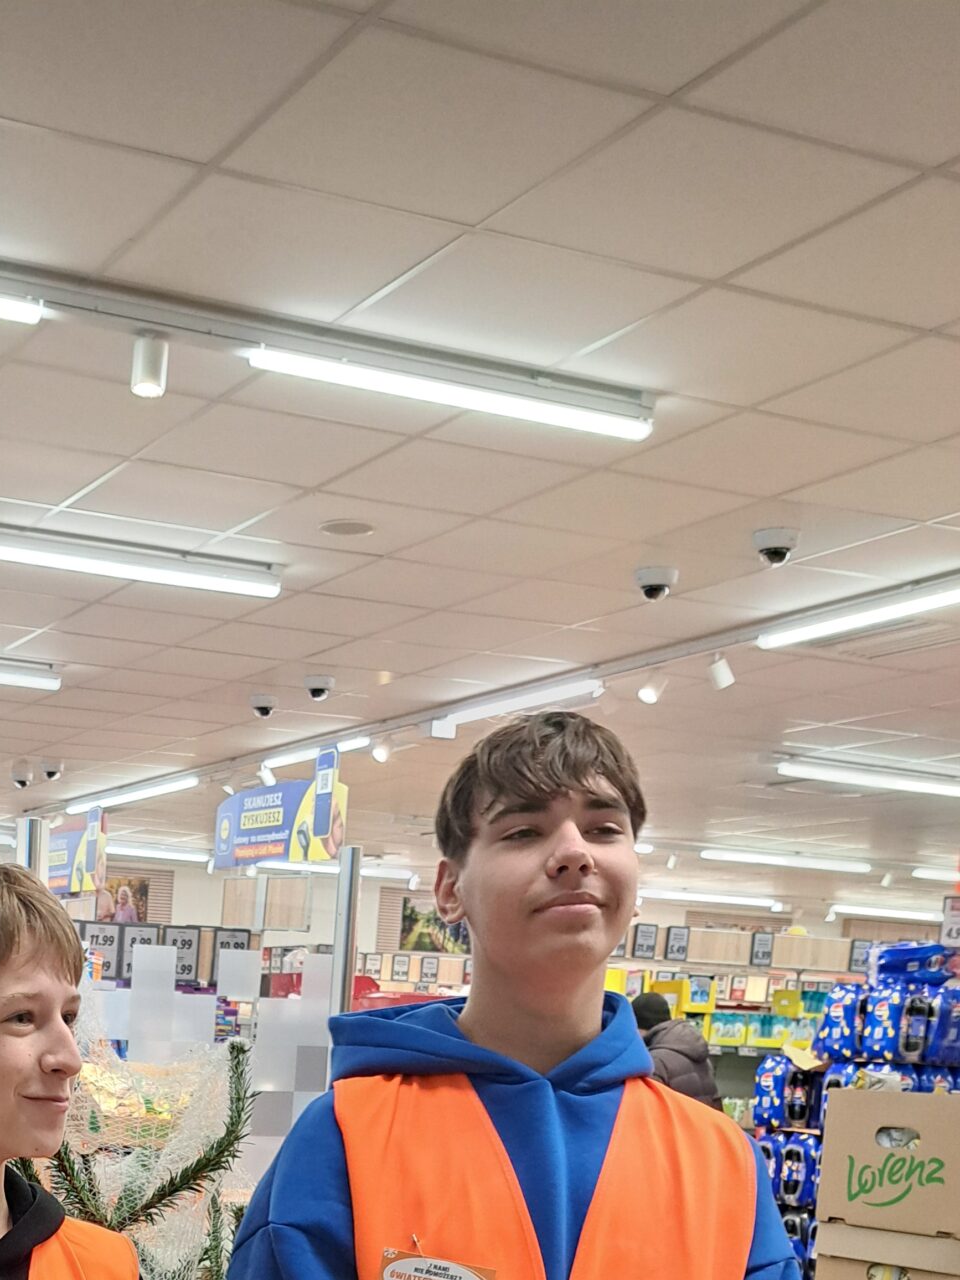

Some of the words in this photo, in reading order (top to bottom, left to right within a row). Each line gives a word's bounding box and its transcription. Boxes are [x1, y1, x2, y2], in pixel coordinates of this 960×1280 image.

[243, 792, 283, 809] SKANUJESZ
[242, 810, 281, 827] ZYSKUJESZ
[90, 934, 115, 947] 11.99
[847, 1153, 946, 1202] Lorenz
[433, 1264, 450, 1273] NAMI
